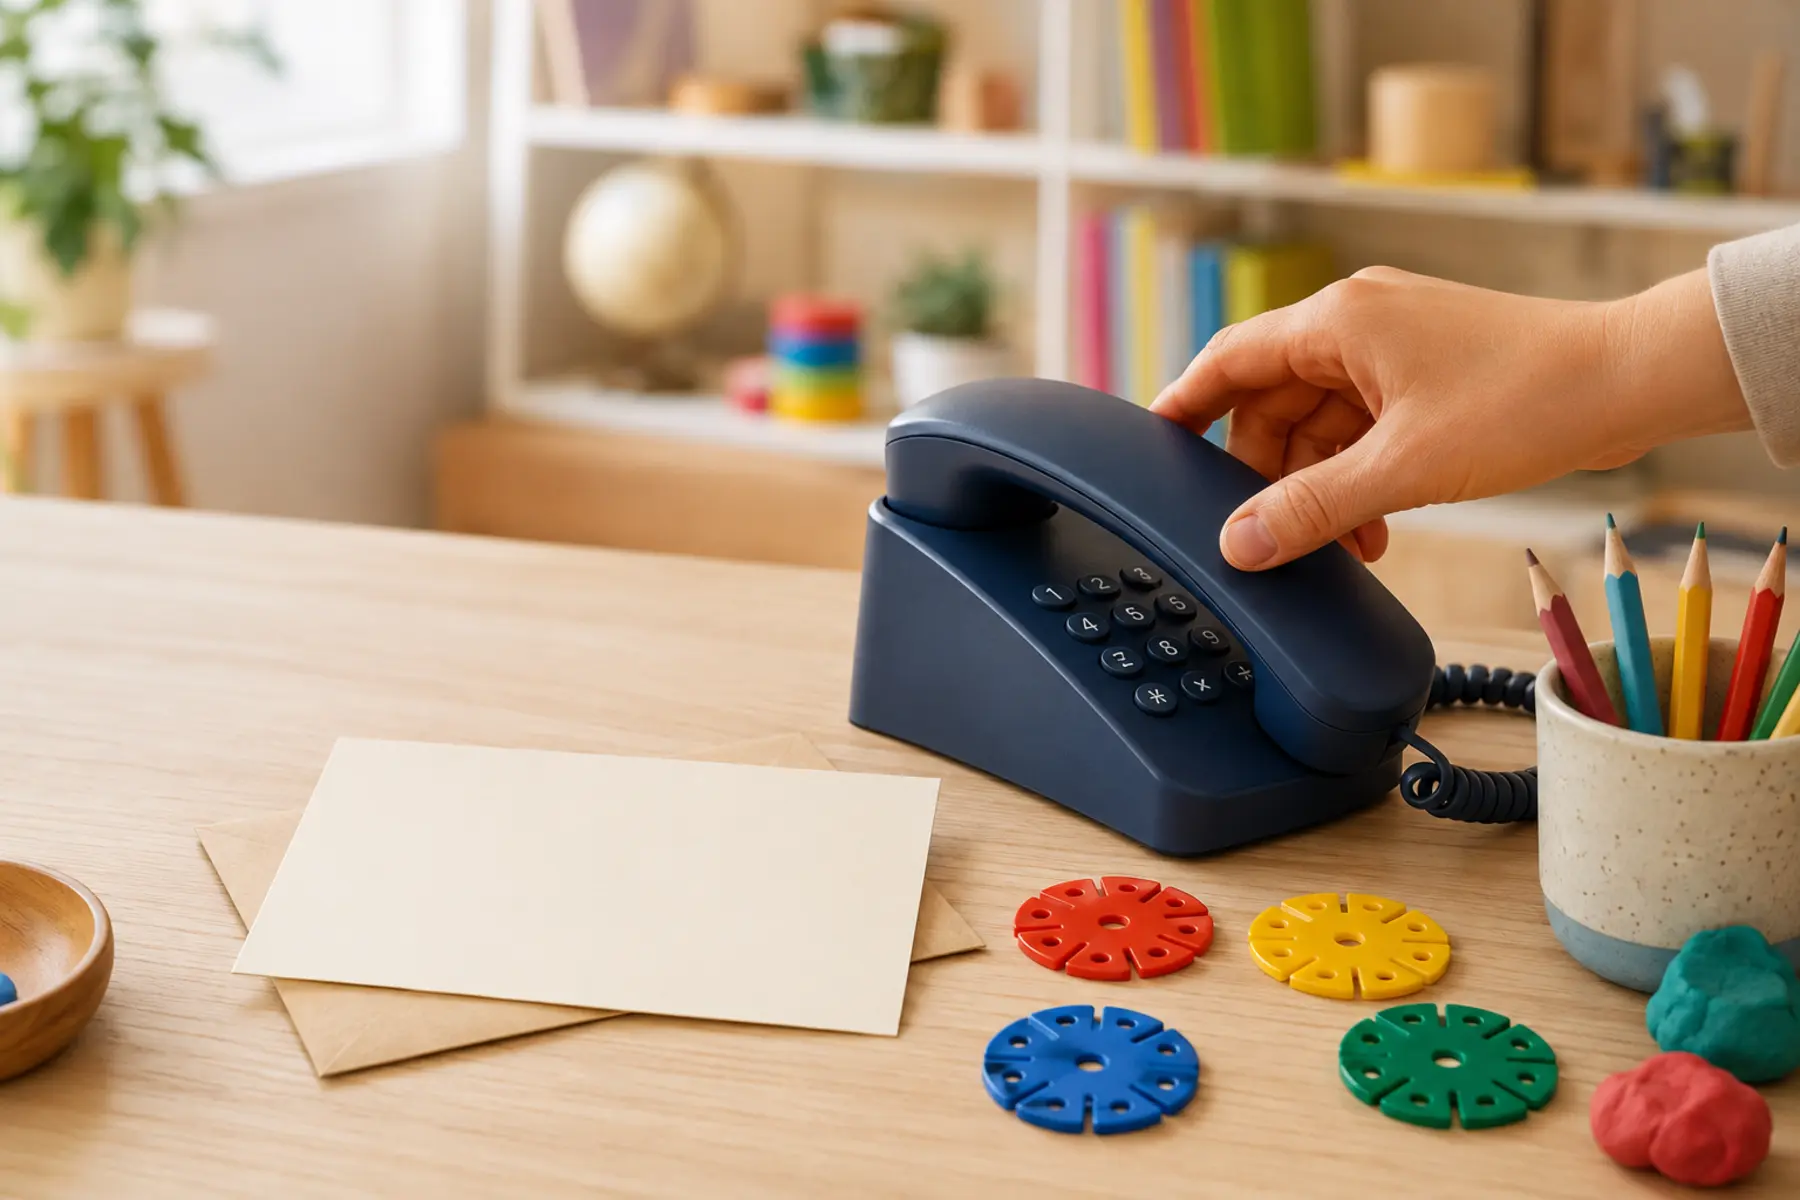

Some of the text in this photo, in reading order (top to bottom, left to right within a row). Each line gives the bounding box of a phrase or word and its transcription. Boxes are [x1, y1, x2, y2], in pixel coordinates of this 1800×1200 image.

[1045, 587, 1062, 600] 1
[1091, 577, 1110, 590] 2
[1082, 617, 1098, 631] 4
[1125, 606, 1144, 621] 5
[1159, 630, 1219, 655] 8 9
